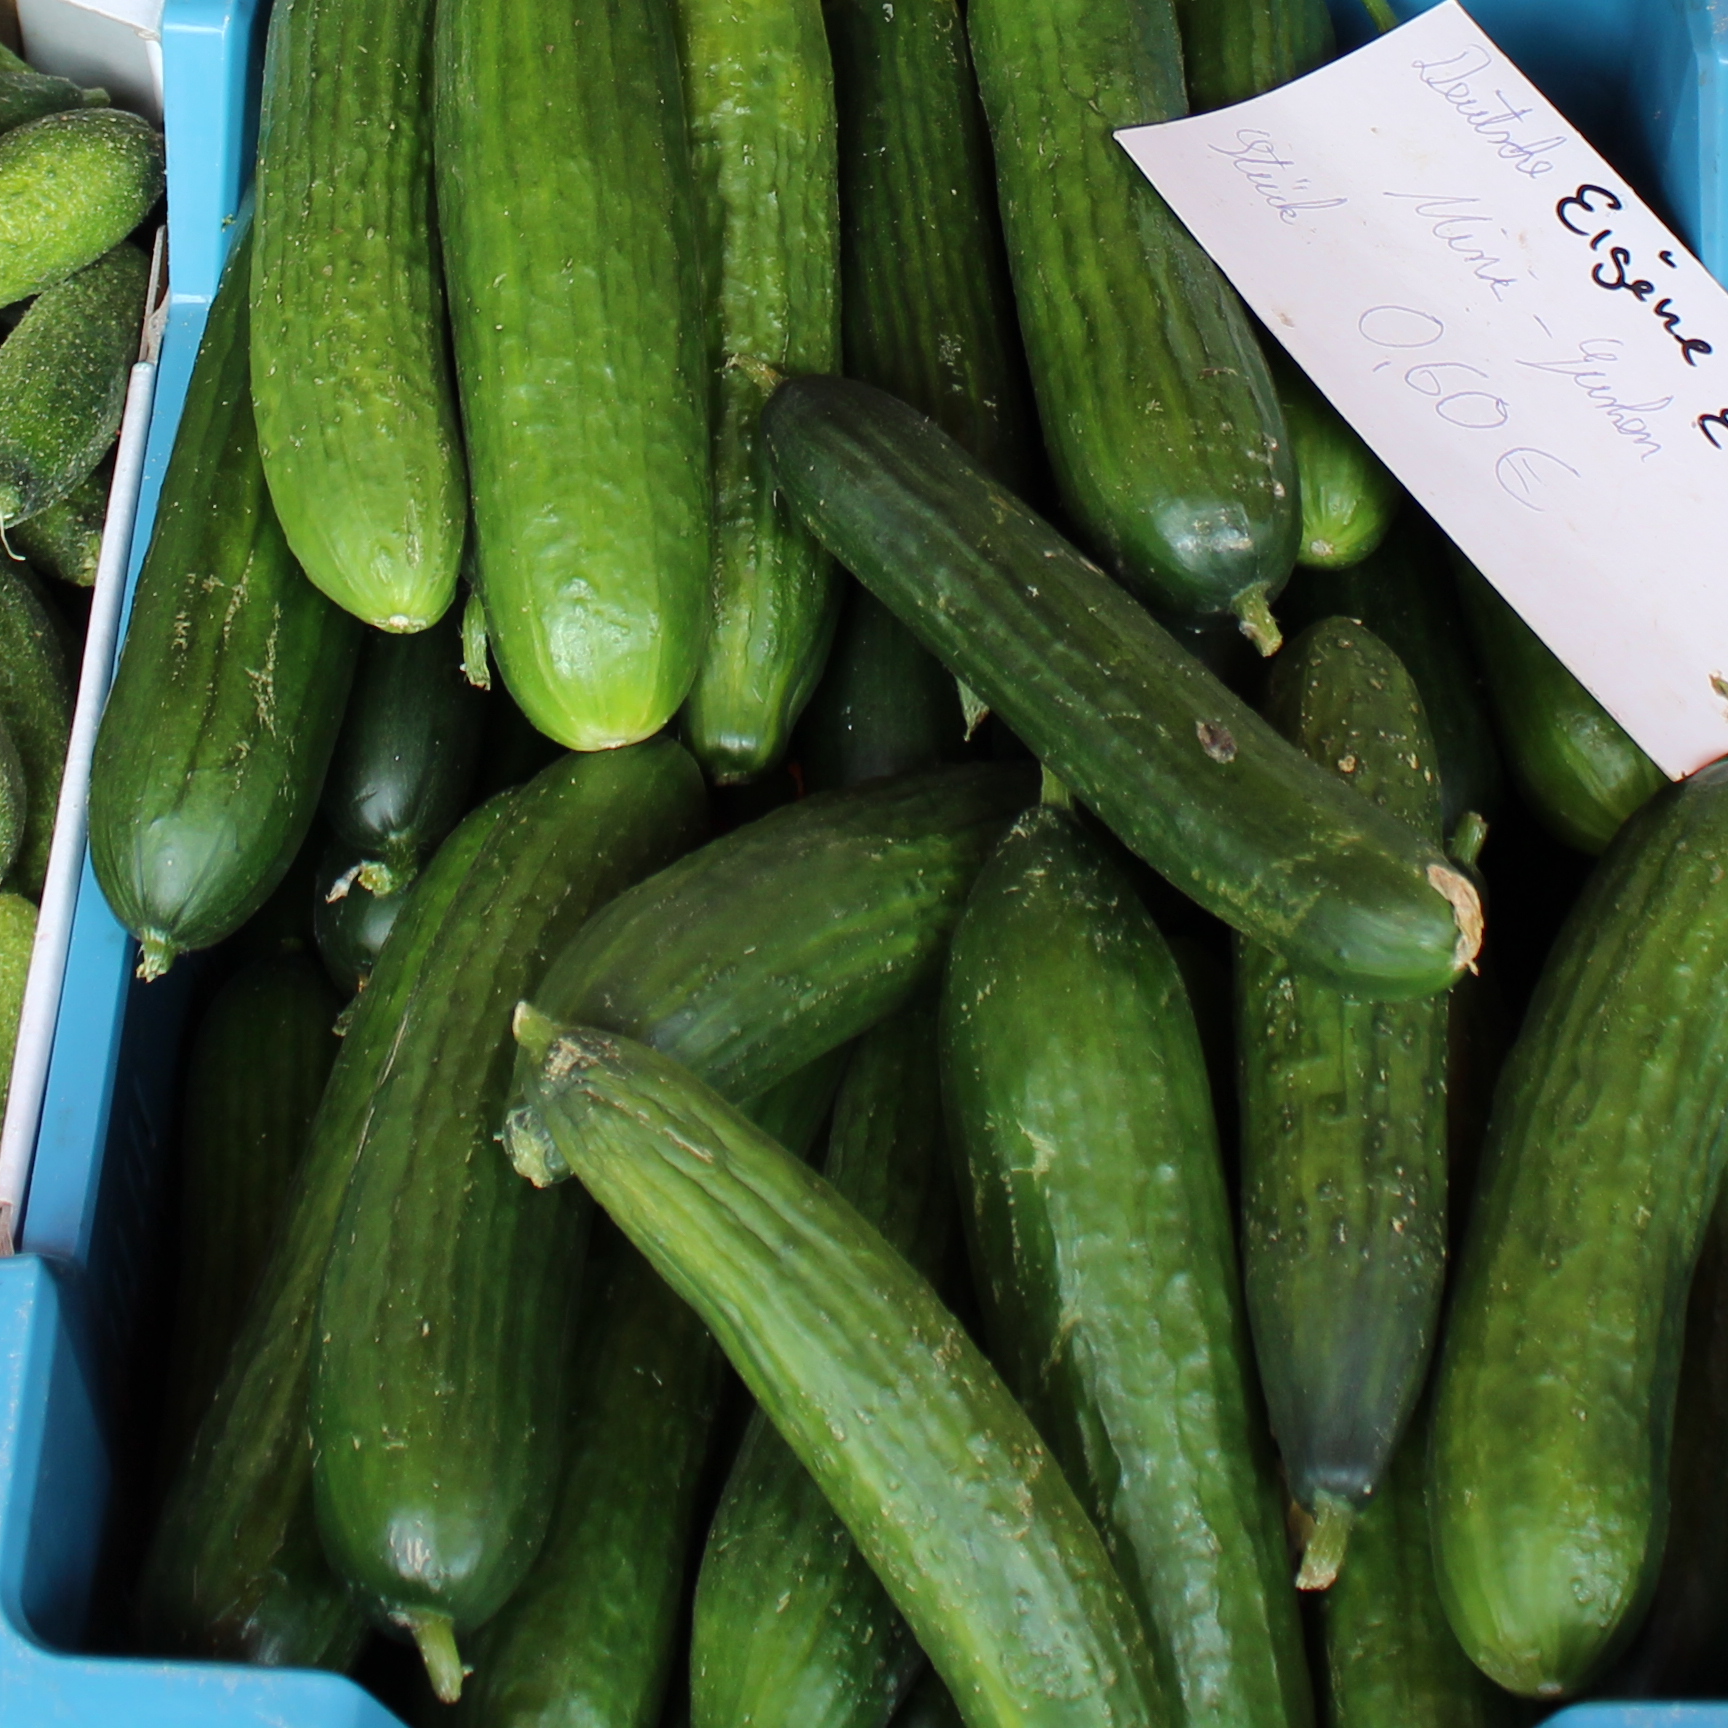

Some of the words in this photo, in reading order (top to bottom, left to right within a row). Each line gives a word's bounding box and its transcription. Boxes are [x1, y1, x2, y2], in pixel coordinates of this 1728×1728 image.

[1207, 128, 1349, 226] Stück
[1556, 183, 1713, 367] Eigene
[1495, 446, 1584, 513] €
